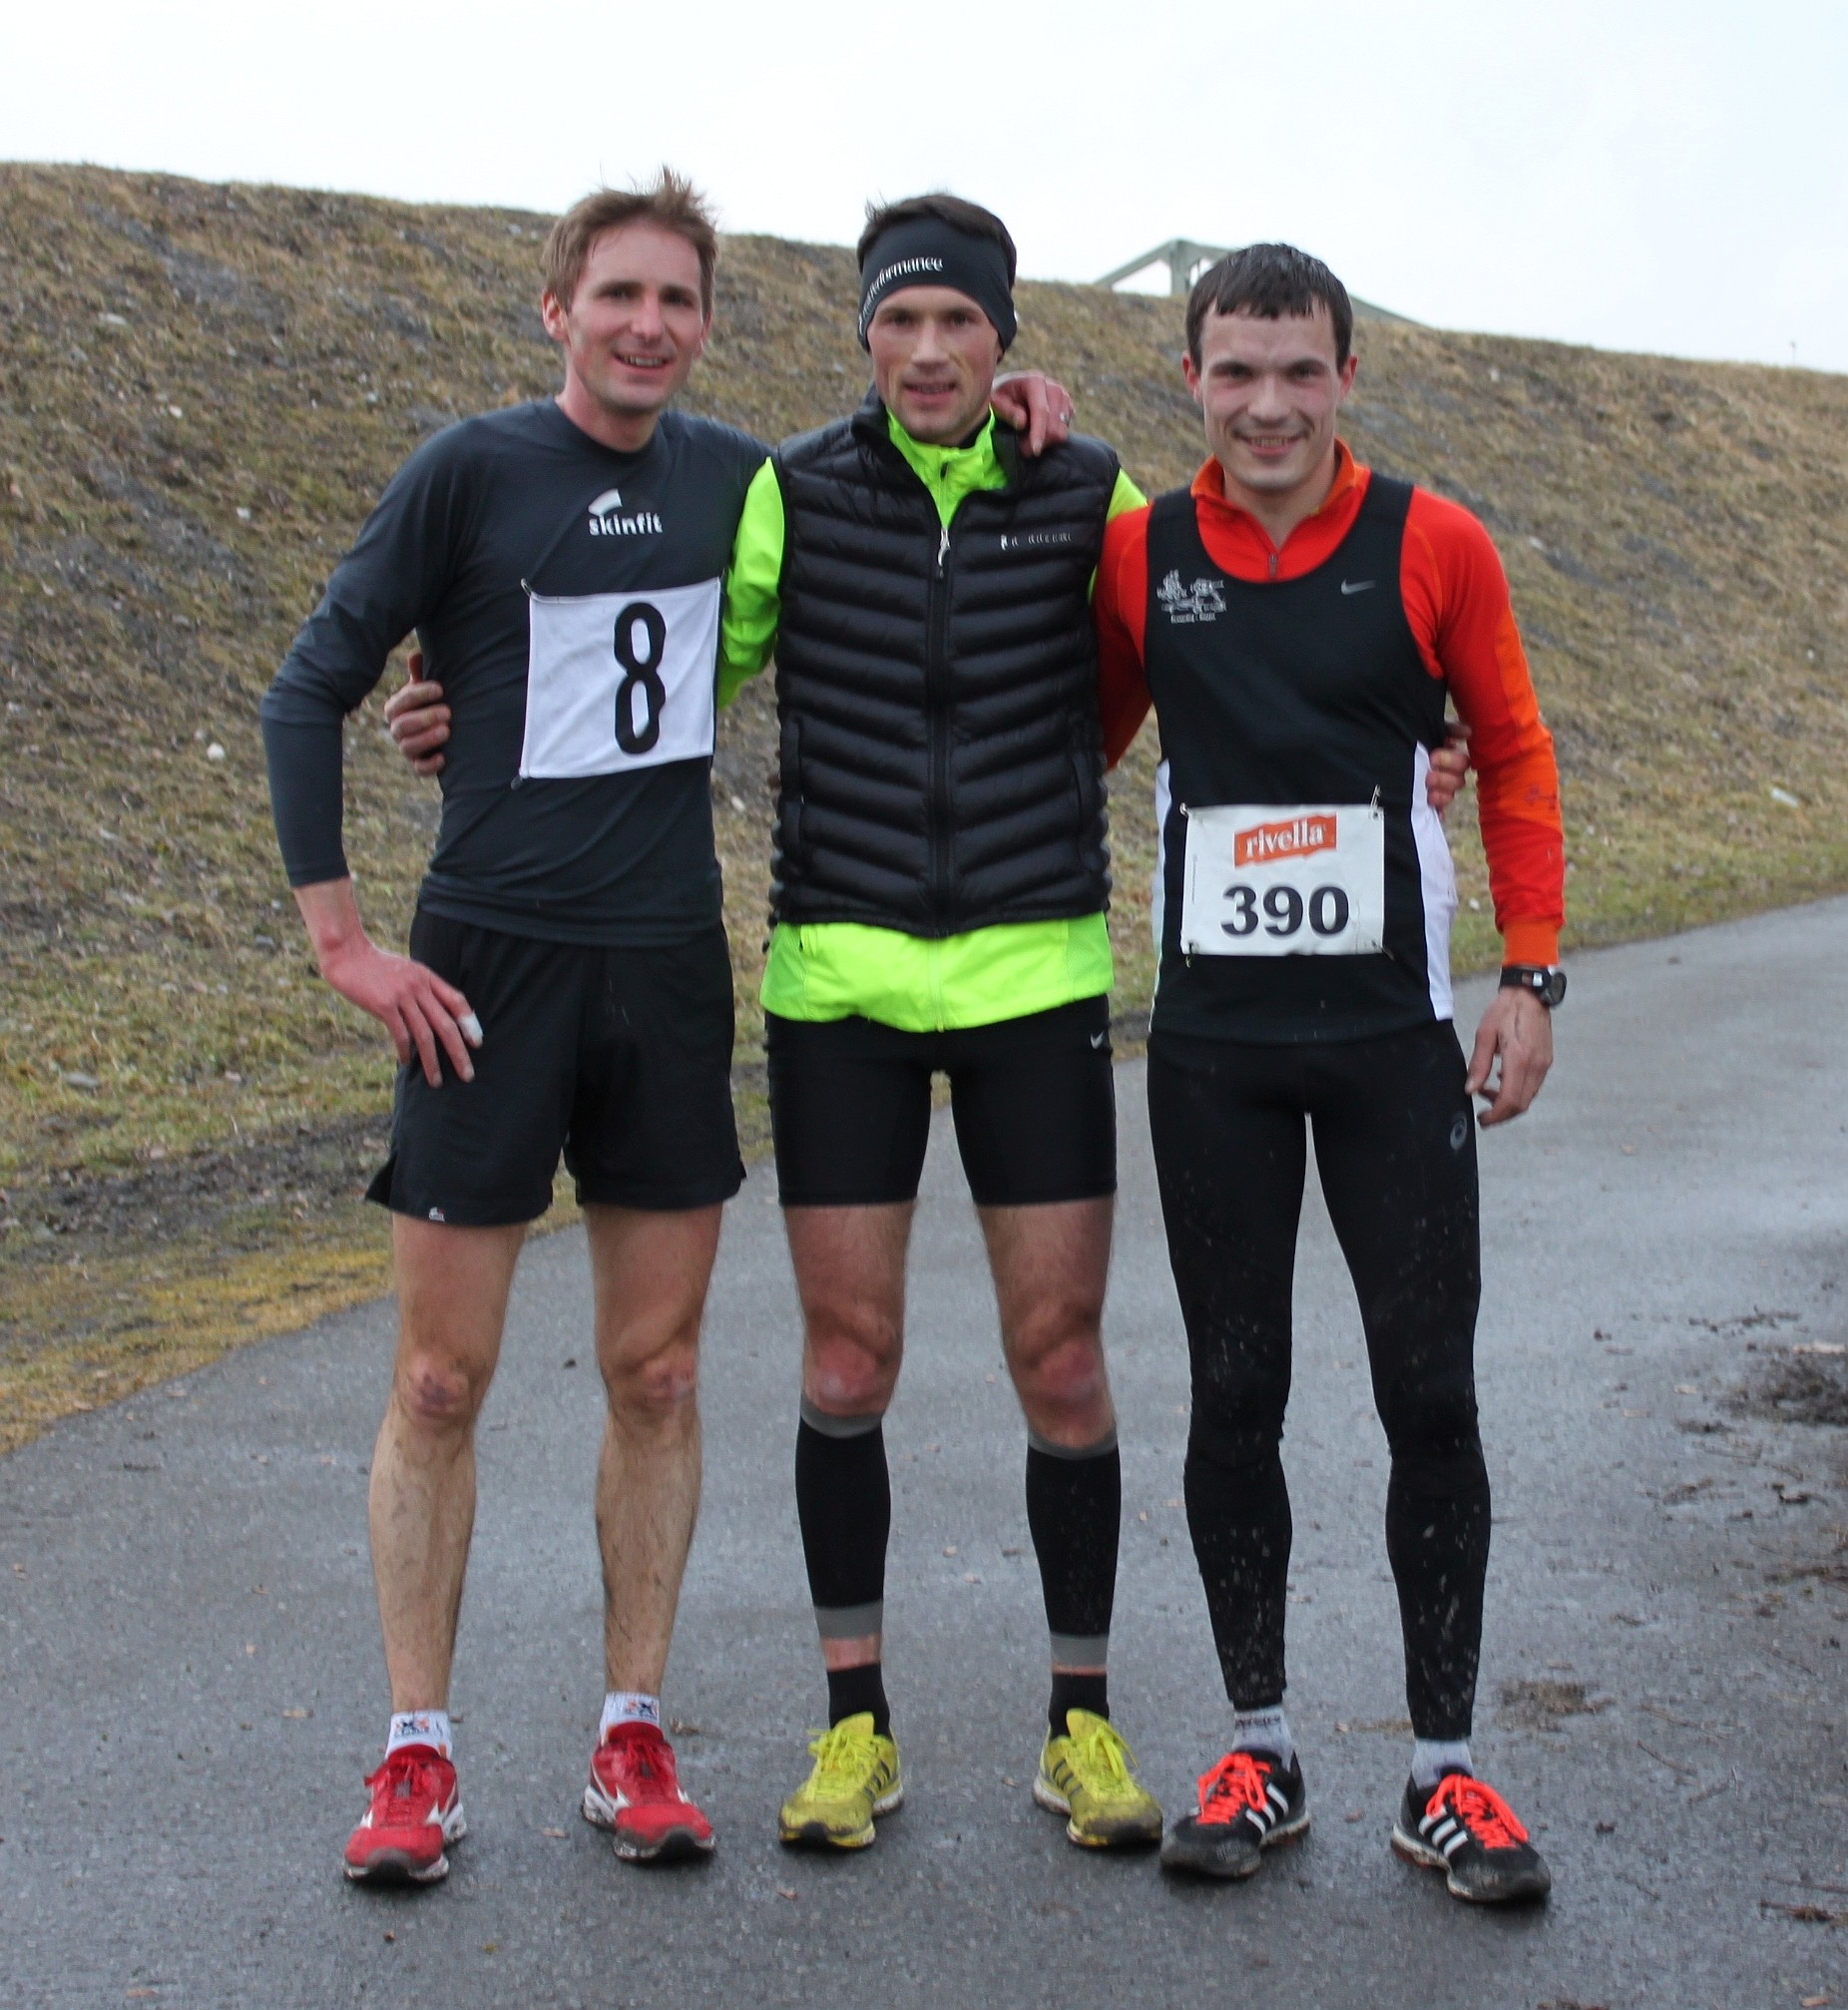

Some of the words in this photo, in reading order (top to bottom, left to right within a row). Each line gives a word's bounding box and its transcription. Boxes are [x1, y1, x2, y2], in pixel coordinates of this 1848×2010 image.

[589, 512, 663, 536] skinfit
[614, 602, 667, 754] 8
[1245, 818, 1325, 858] rivella
[1220, 885, 1349, 937] 390
